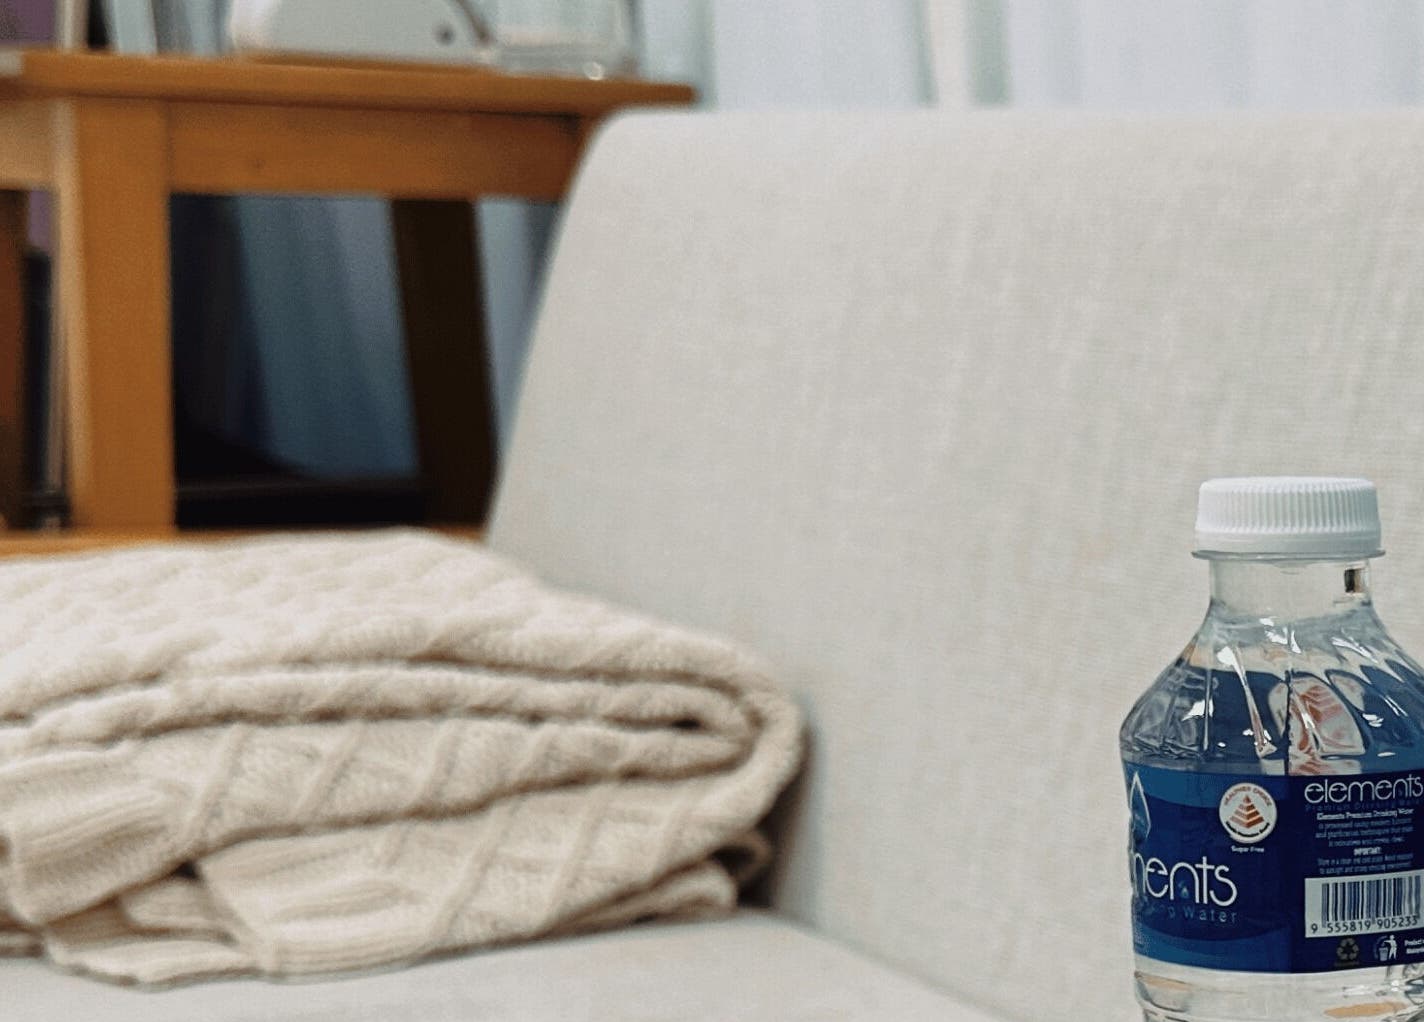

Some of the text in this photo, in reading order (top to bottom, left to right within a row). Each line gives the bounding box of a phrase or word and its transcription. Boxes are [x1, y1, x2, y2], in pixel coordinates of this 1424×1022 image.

[1304, 774, 1423, 803] elements
[1183, 905, 1238, 923] Water
[1311, 915, 1418, 934] 9 555819 905233
